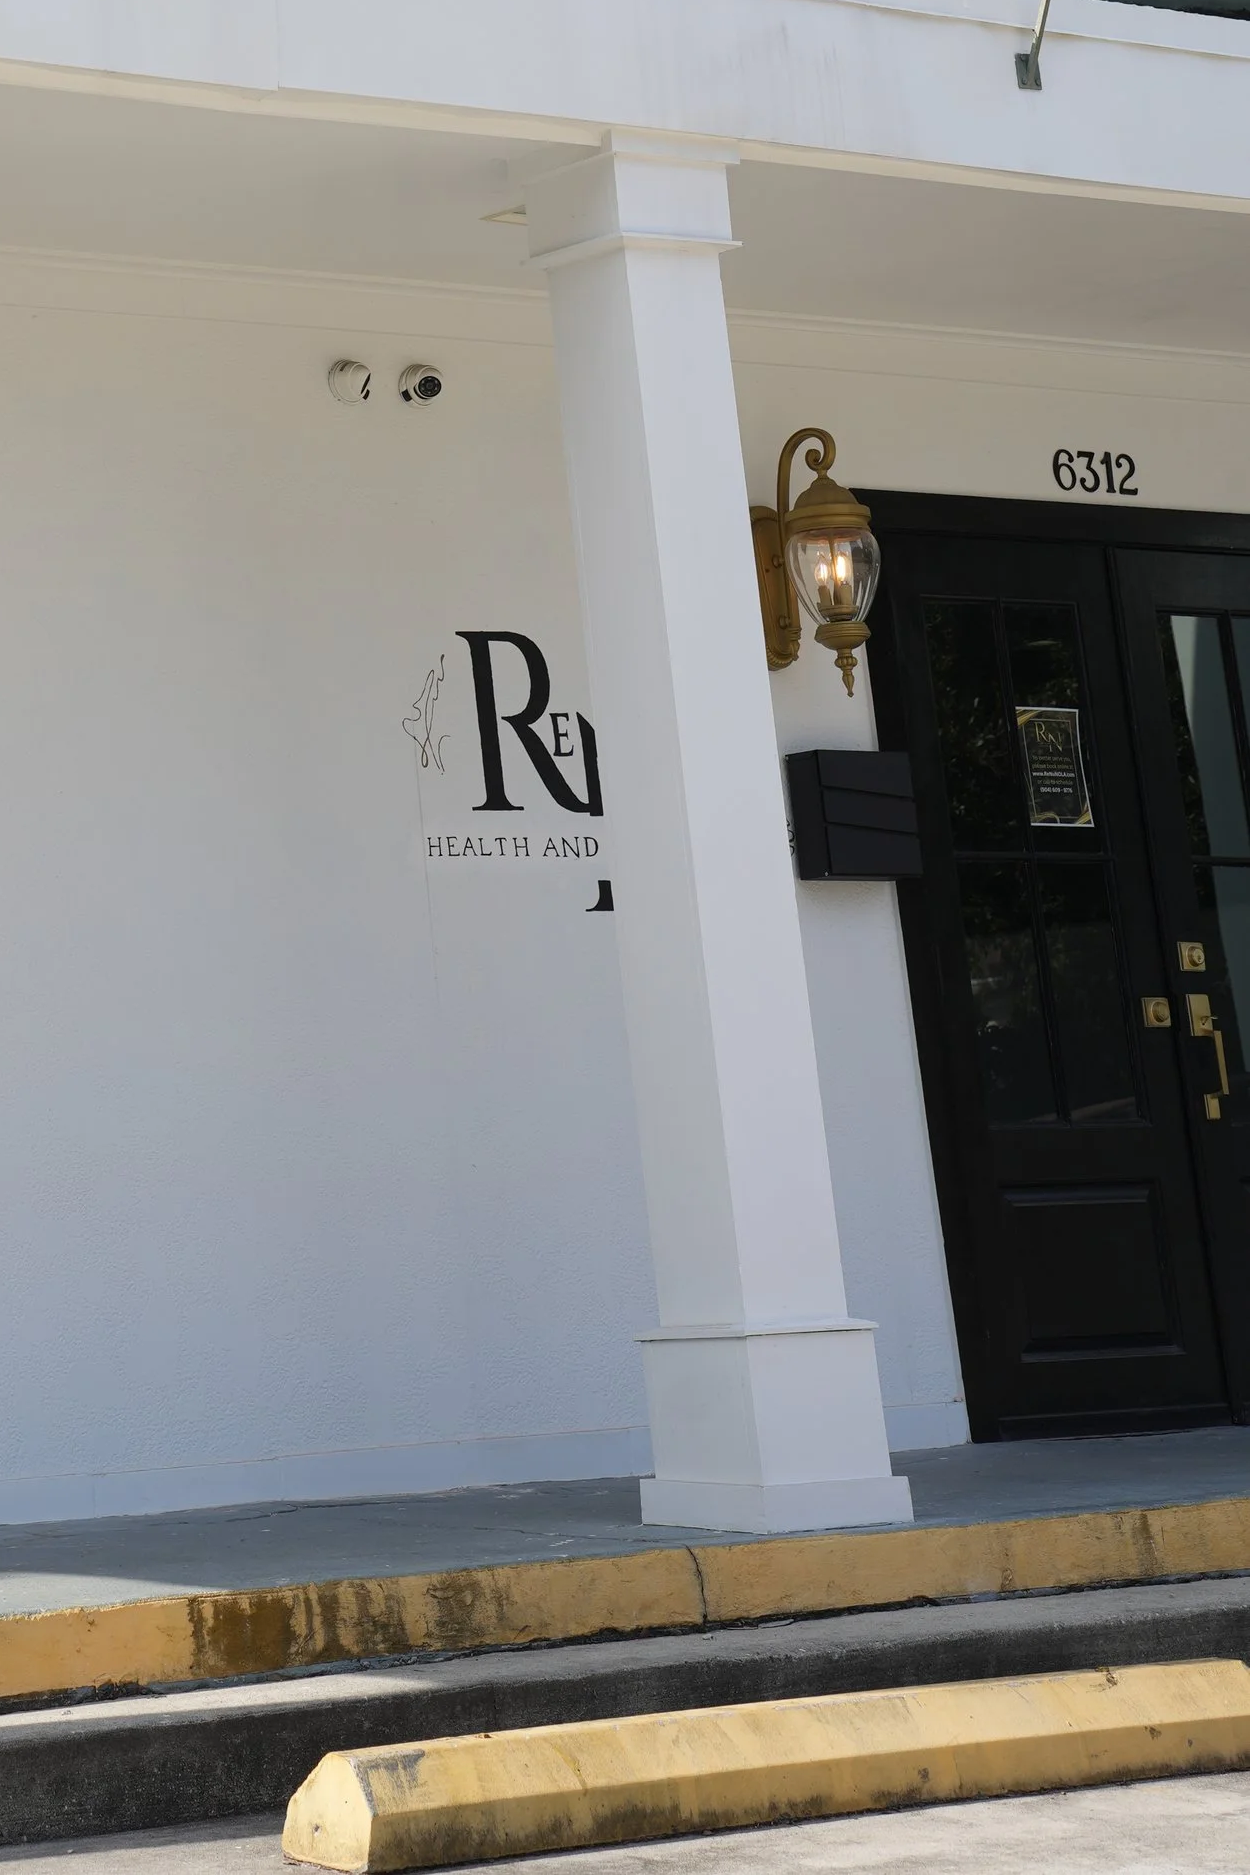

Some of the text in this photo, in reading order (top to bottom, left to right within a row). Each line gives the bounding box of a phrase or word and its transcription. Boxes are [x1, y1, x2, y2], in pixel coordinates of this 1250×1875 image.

[1052, 448, 1139, 496] 6312
[426, 836, 600, 859] HEALTH AND
